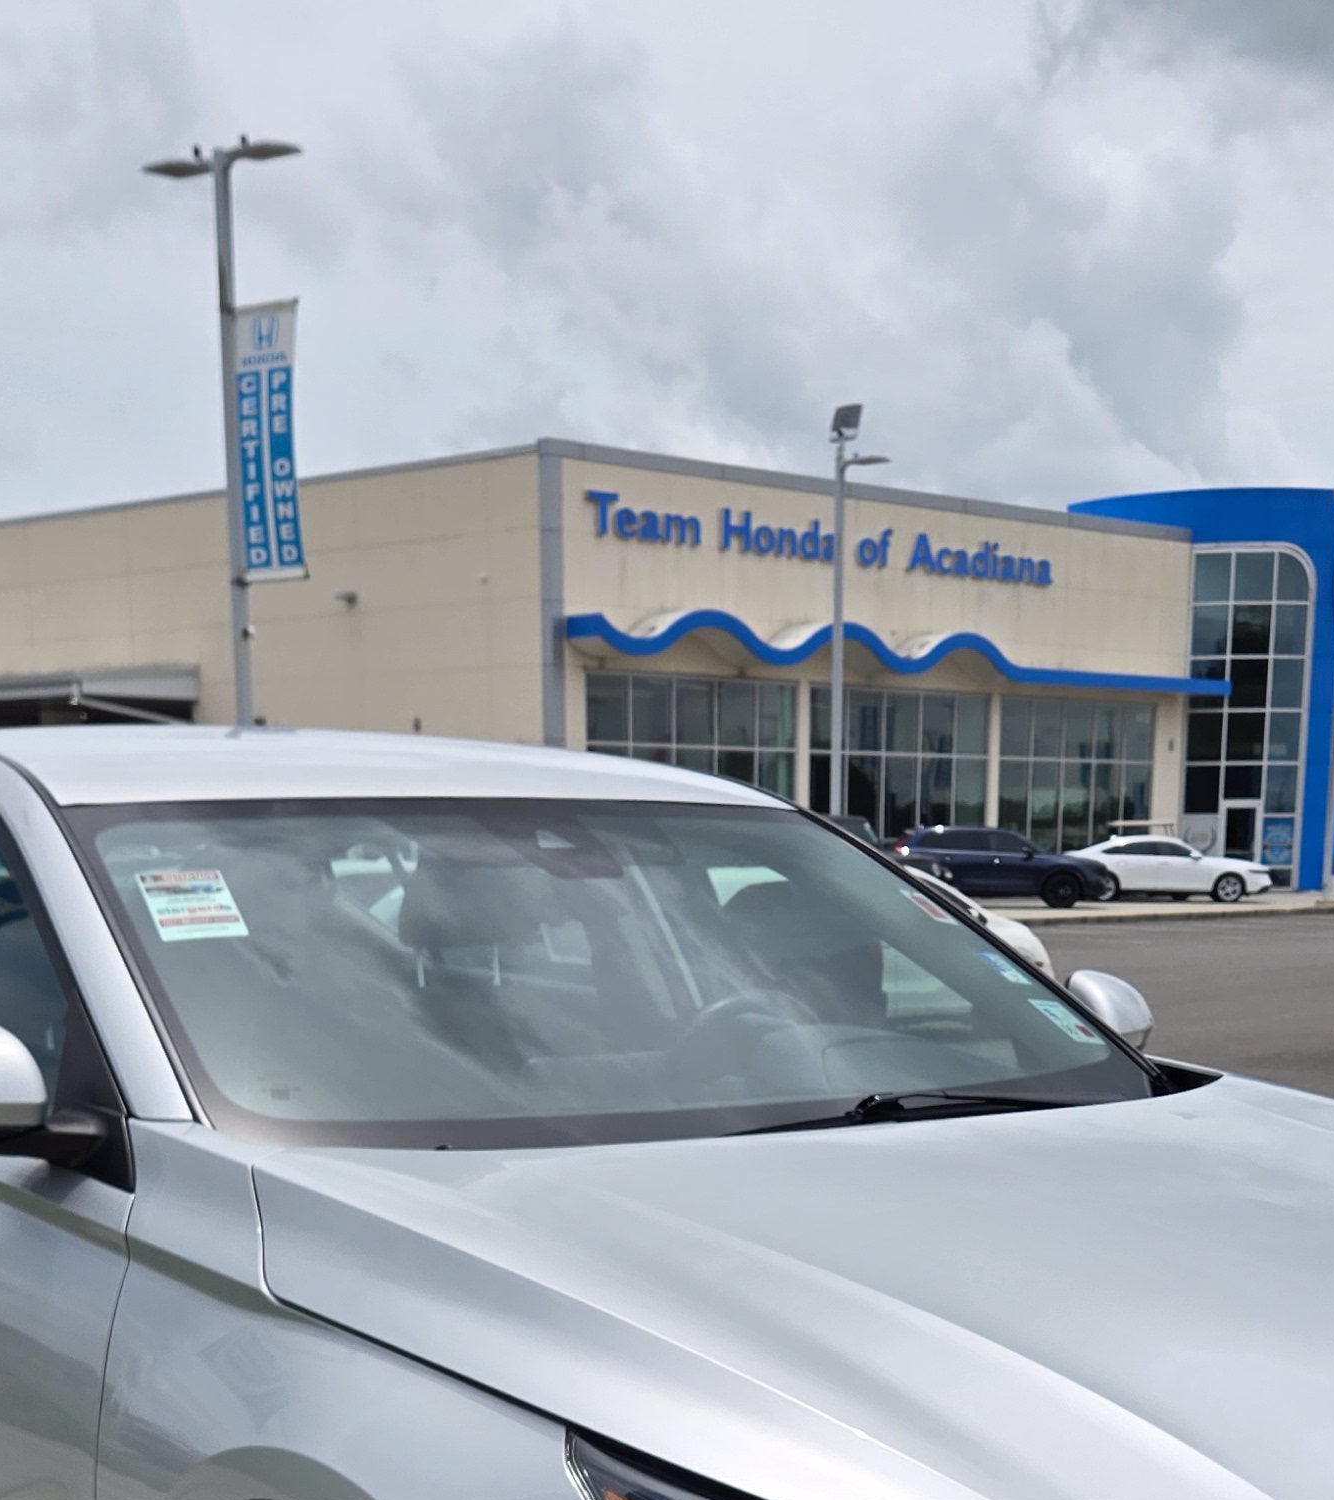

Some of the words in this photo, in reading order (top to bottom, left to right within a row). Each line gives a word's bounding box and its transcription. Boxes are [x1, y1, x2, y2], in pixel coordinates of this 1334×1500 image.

[270, 370, 289, 433] PRE
[239, 375, 268, 564] CERTIFIED
[272, 457, 299, 562] OWNED
[584, 489, 702, 548] Team
[720, 507, 835, 564] Honda
[857, 528, 893, 569] of
[906, 532, 1053, 587] Acadiana
